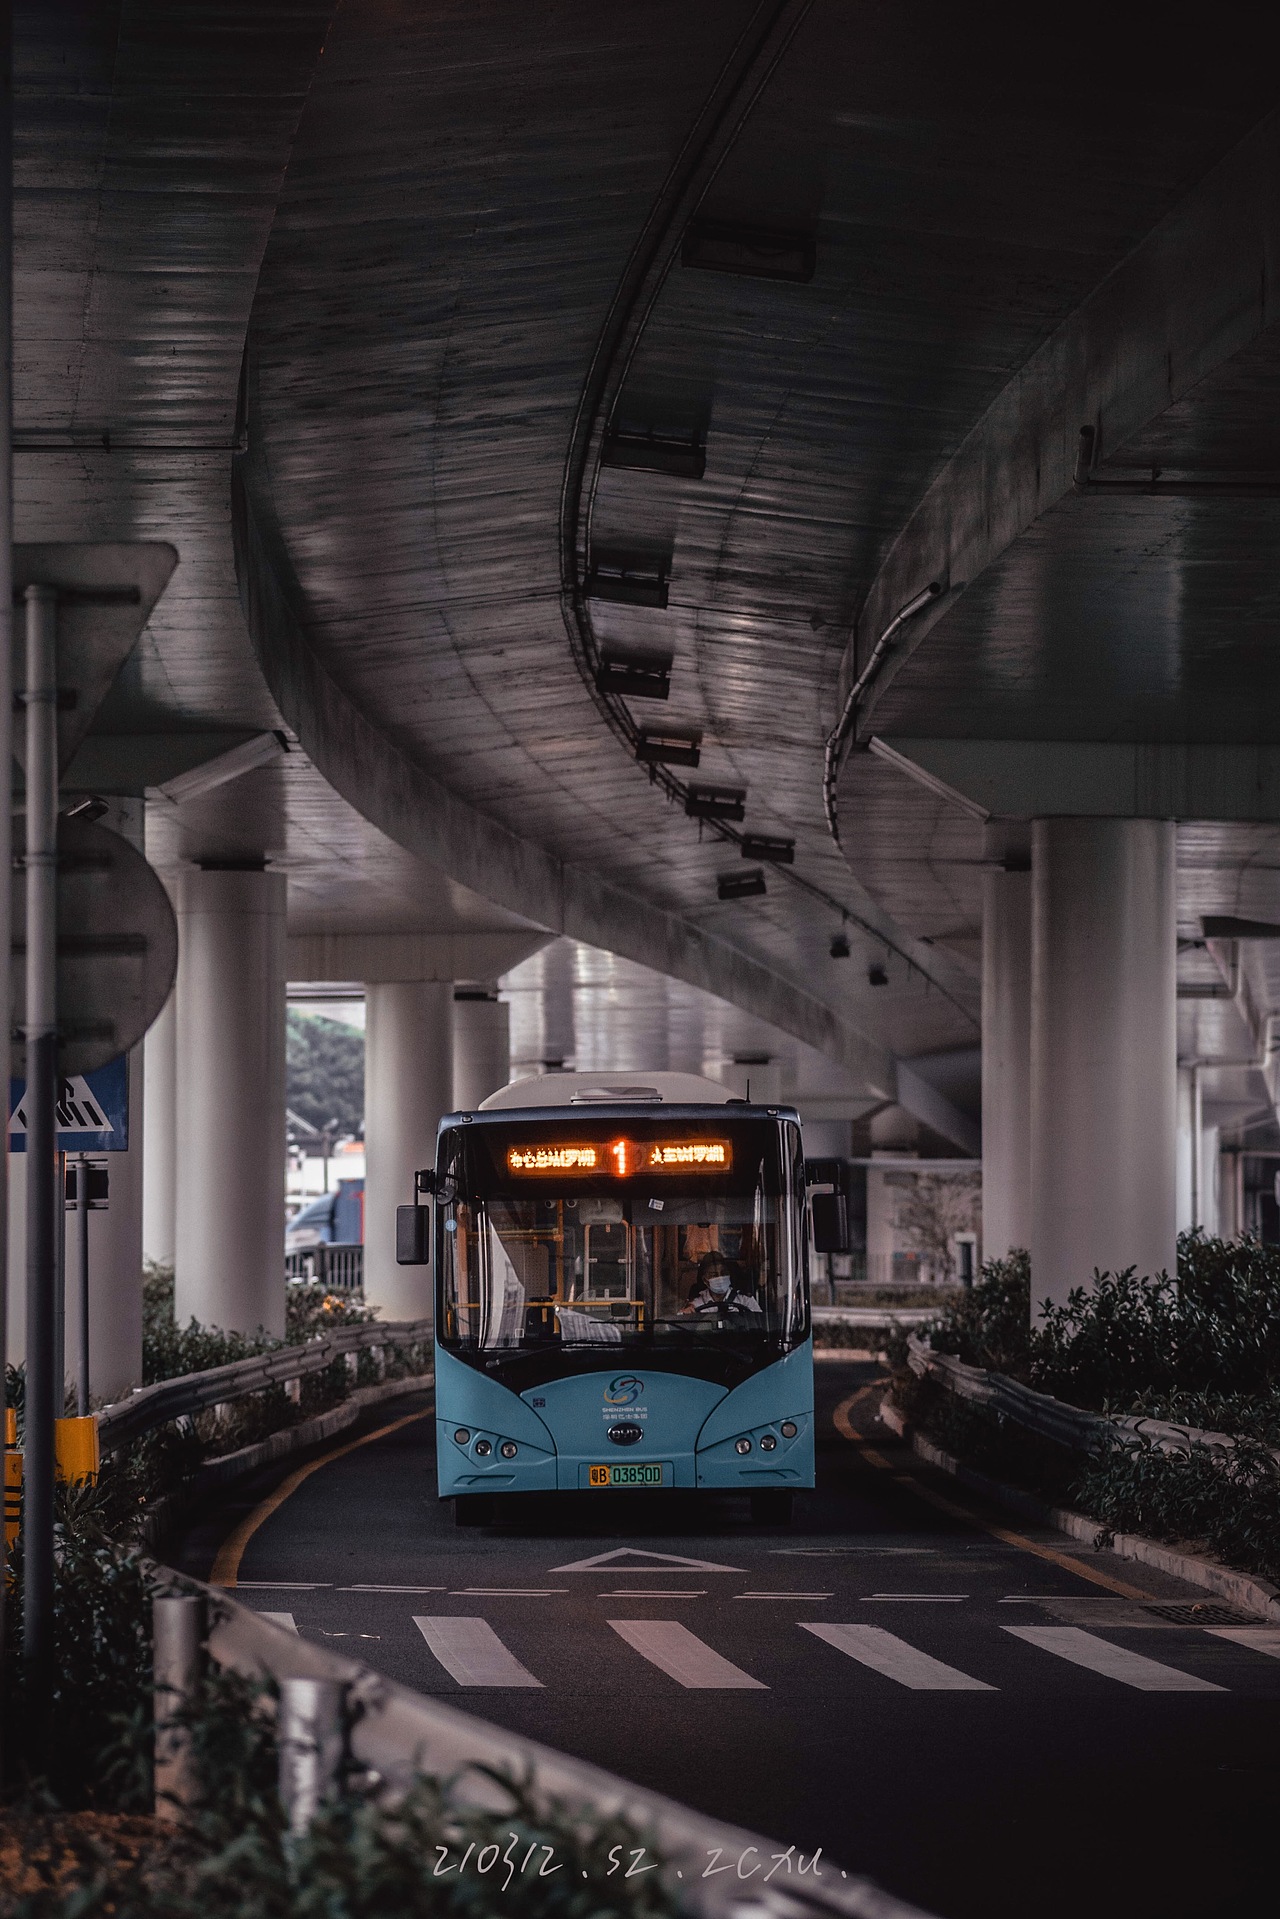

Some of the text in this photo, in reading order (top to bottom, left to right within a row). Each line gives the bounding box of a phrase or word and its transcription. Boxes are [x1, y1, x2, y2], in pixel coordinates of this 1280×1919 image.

[613, 1141, 626, 1174] 1
[611, 1429, 639, 1439] BYD
[613, 1466, 661, 1483] 03850D
